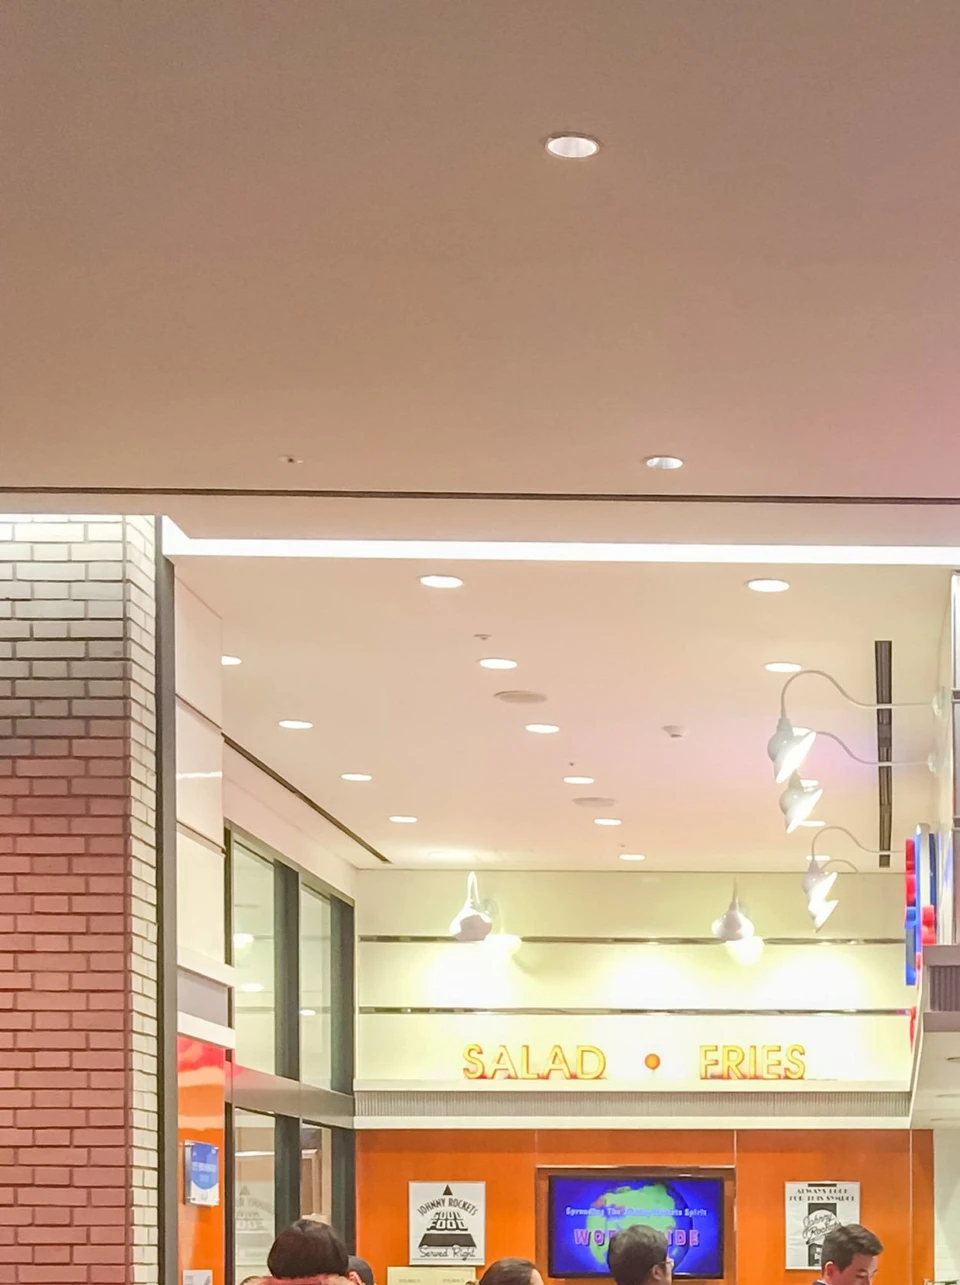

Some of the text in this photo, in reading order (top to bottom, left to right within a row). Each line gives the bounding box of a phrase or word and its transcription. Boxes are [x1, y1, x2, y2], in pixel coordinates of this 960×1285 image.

[462, 1043, 806, 1080] SALAD FRIES
[417, 1198, 478, 1216] JOHNNY ROCKETS
[607, 1206, 621, 1216] The
[427, 1220, 468, 1231] FOOD
[420, 1245, 476, 1261] Served Right
